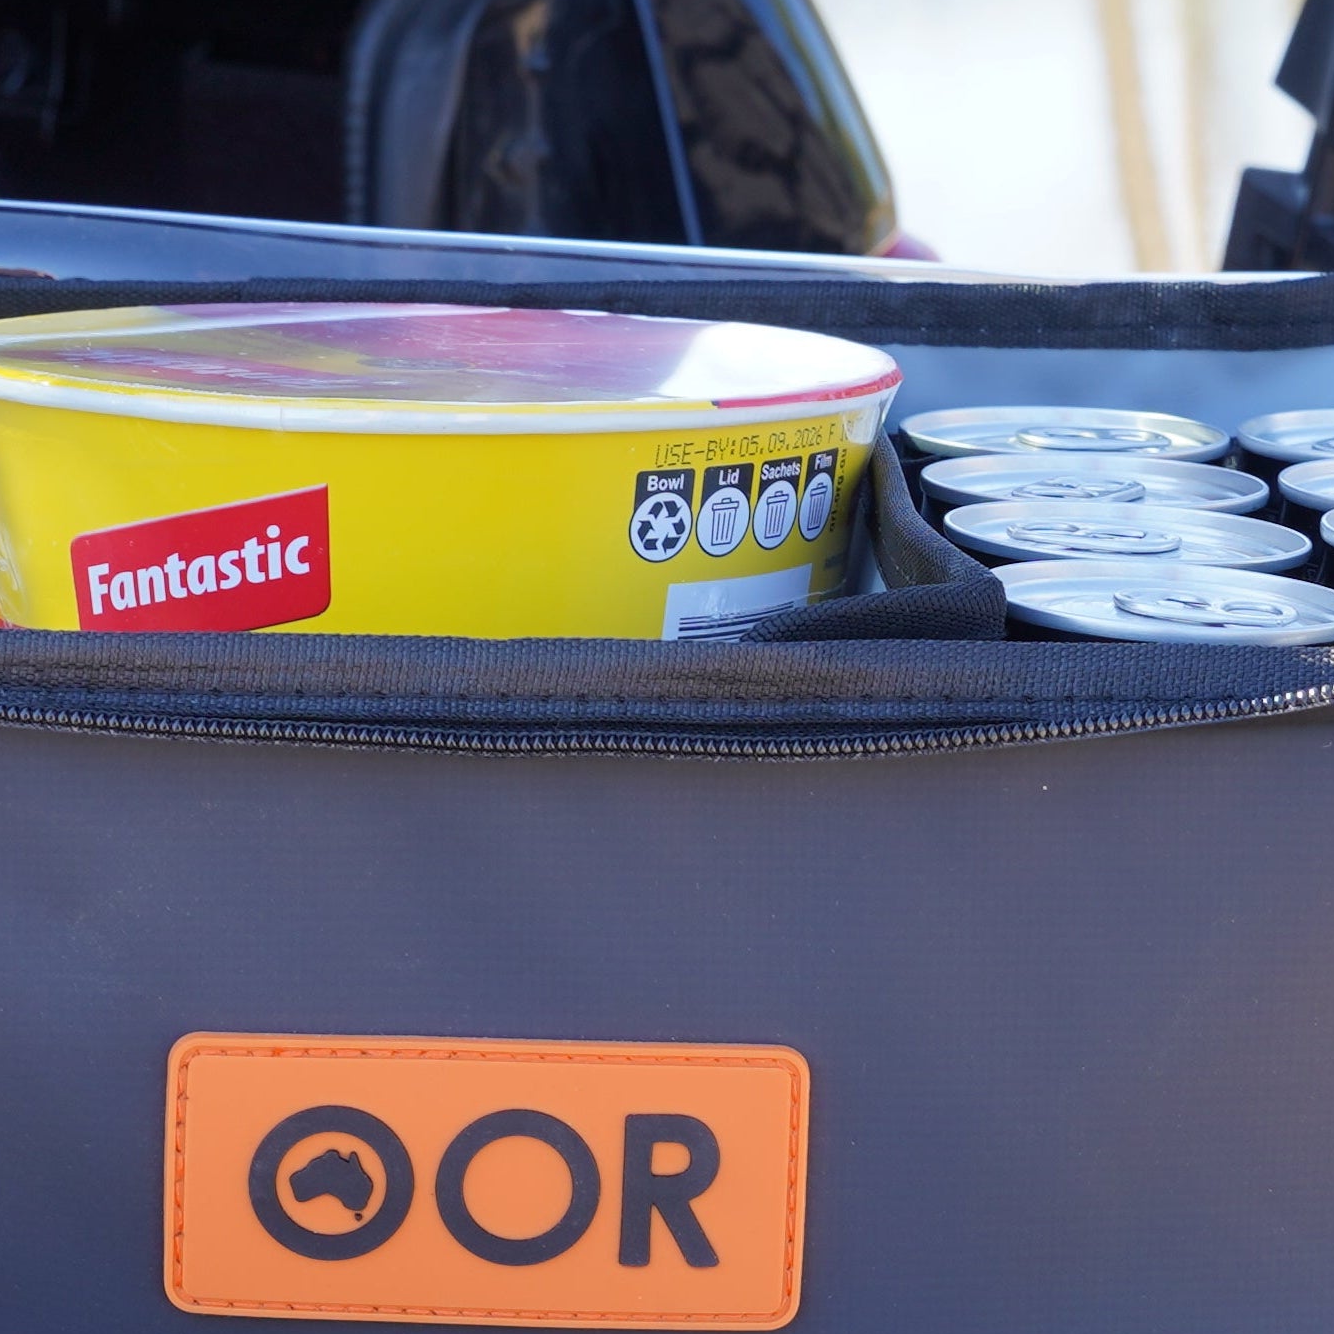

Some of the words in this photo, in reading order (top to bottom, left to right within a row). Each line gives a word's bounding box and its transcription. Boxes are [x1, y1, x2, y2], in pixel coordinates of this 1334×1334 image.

[760, 460, 801, 480] Sachets
[814, 453, 833, 470] Film
[647, 474, 685, 492] Bowl
[718, 468, 740, 485] Lid
[87, 524, 311, 615] Fantastic
[247, 1104, 721, 1268] OOR
